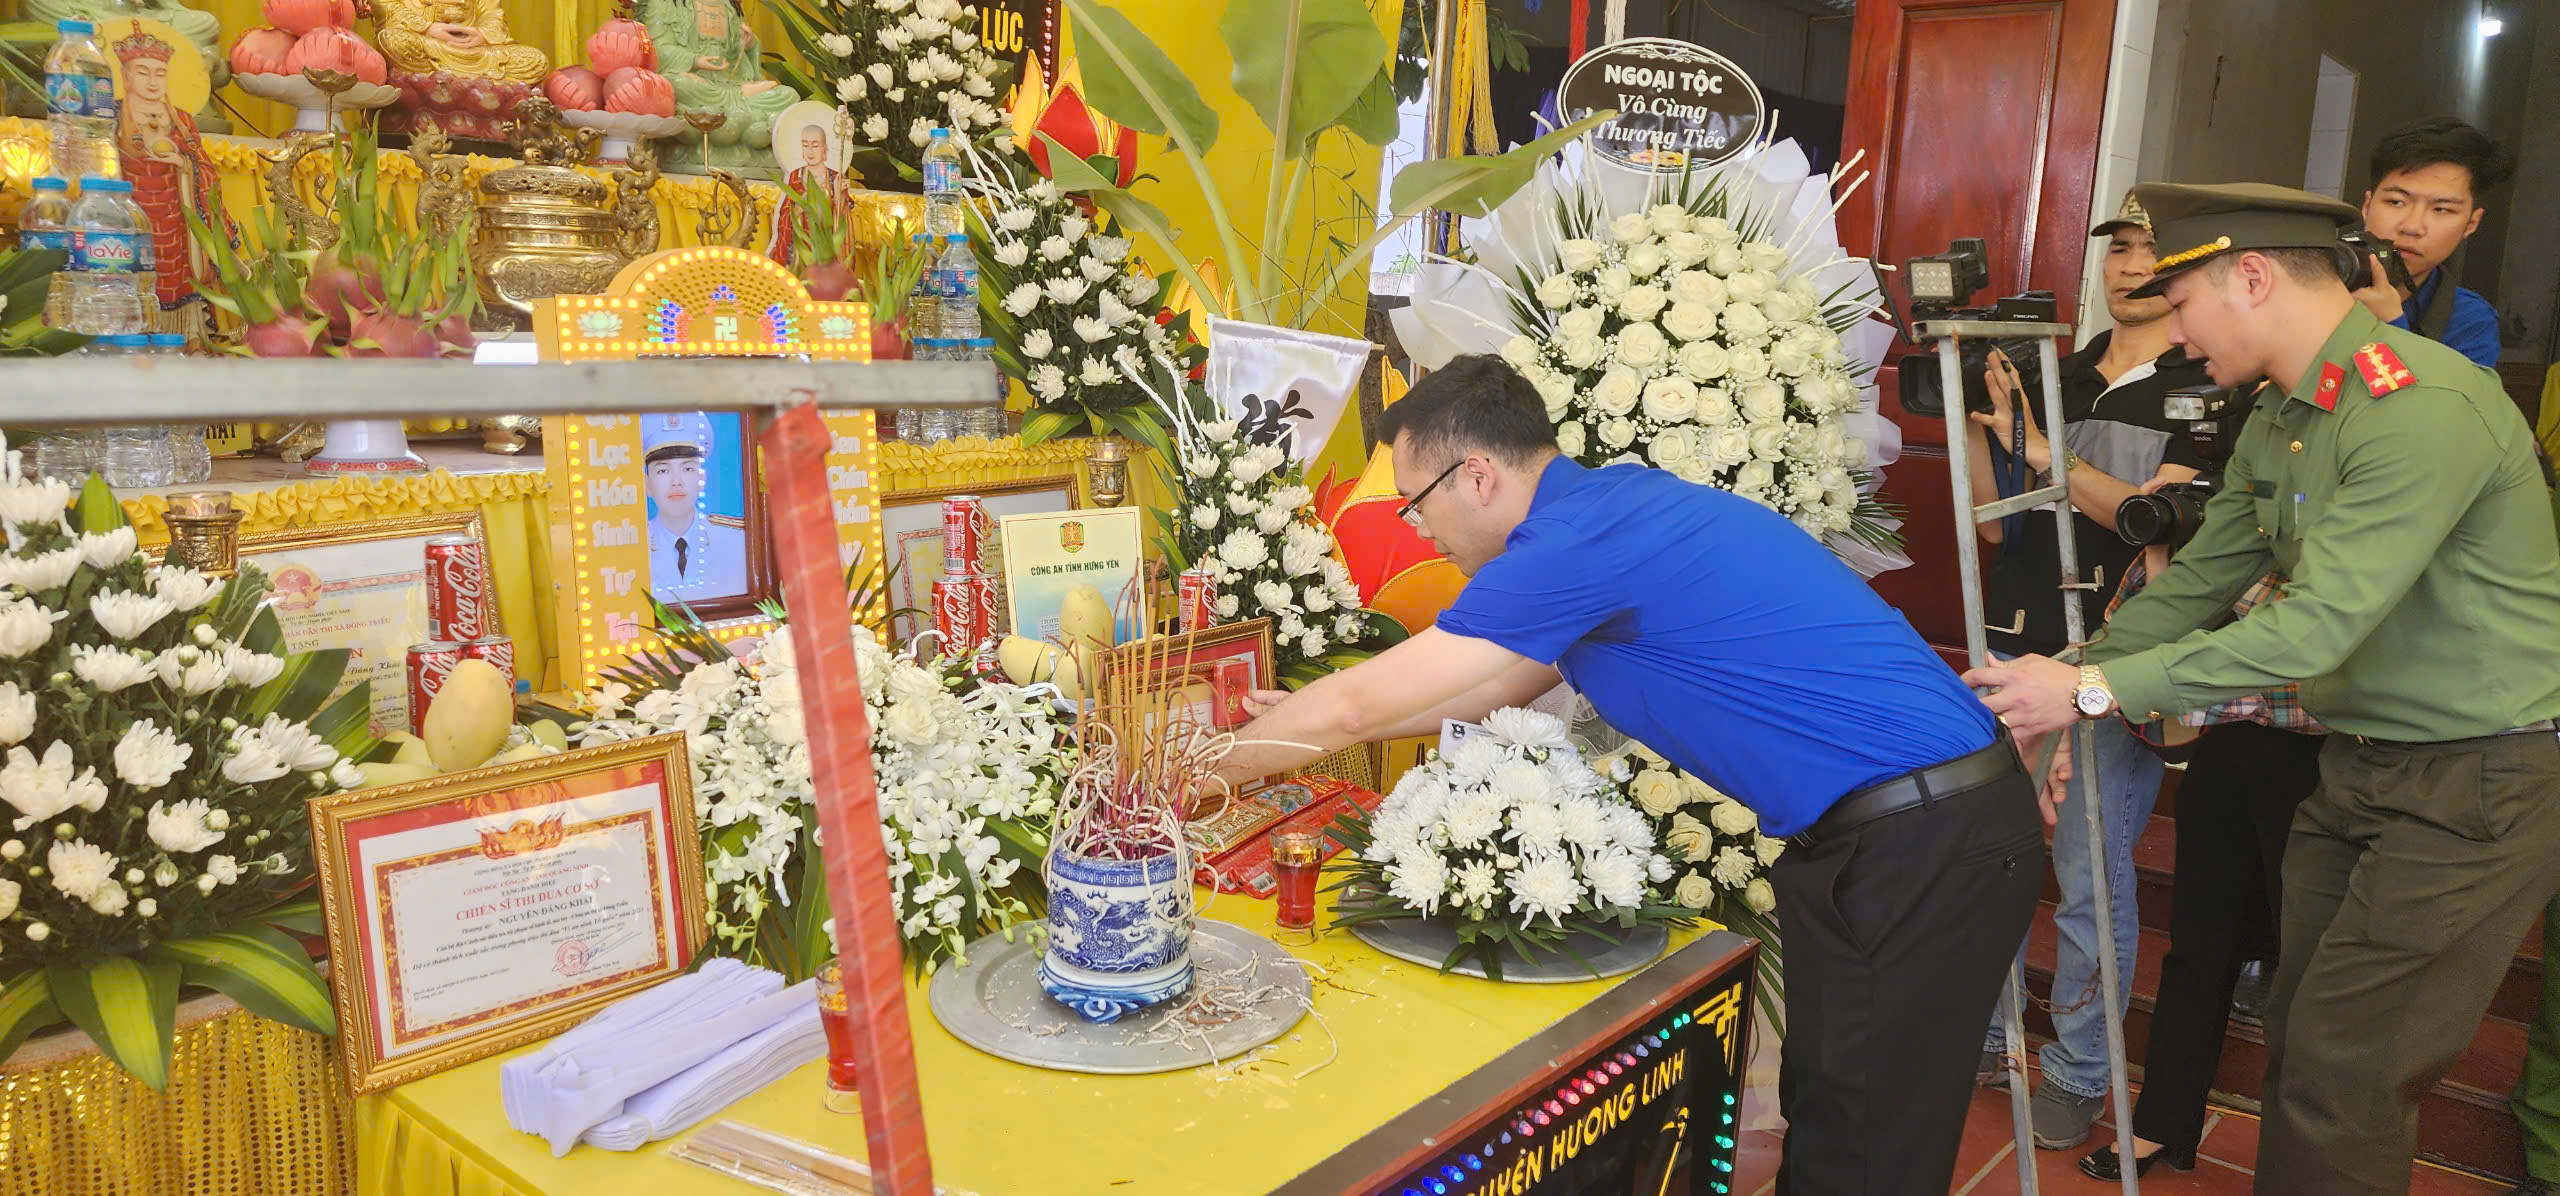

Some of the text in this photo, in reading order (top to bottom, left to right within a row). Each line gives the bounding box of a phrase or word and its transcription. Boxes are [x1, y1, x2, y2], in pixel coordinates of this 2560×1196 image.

[982, 1, 1024, 53] LÚC
[1604, 64, 1723, 97] NGOẠI TỘC
[1617, 93, 1708, 124] Vô Cùng
[1596, 120, 1726, 150] Thương Tiếc
[588, 437, 632, 471] Lạc
[2015, 419, 2024, 457] SONY
[587, 475, 638, 508] Hóa
[591, 518, 639, 548] Sinh
[600, 567, 636, 597] Tự
[1053, 564, 1063, 574] AN
[515, 894, 537, 908] THI
[1642, 1048, 1686, 1106] LINH
